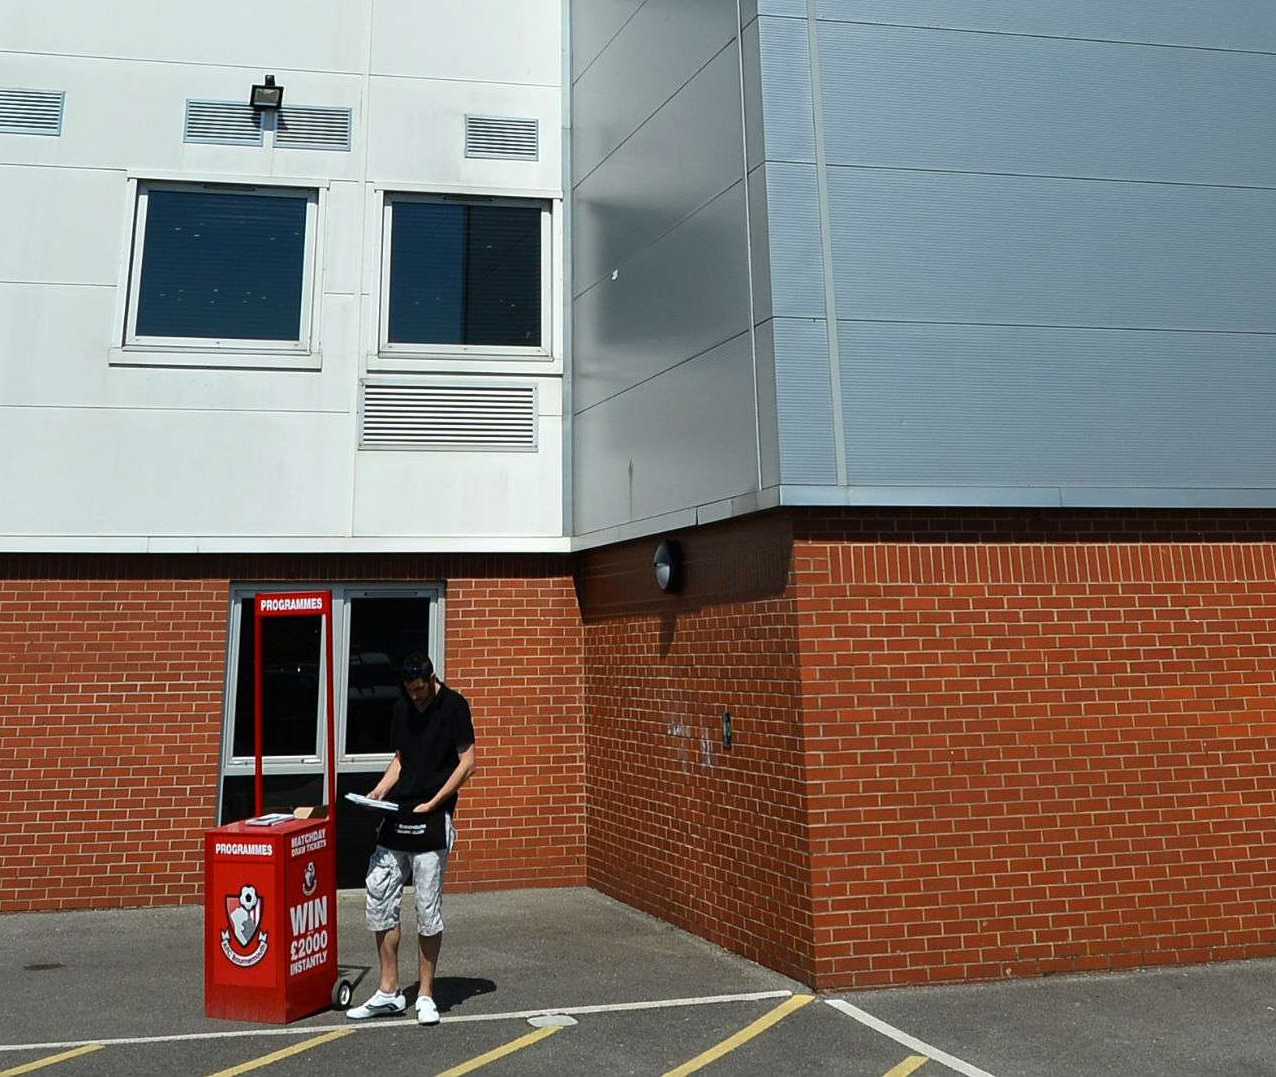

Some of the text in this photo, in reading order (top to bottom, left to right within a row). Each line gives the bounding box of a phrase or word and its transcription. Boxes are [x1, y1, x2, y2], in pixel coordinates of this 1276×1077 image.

[260, 597, 323, 612] PROGRAMMES
[215, 843, 273, 856] PROGRAMMES
[291, 828, 326, 848] MATCHDAY
[290, 895, 328, 937] WIN
[290, 930, 328, 961] £2000
[290, 950, 328, 976] INSTANTLY
